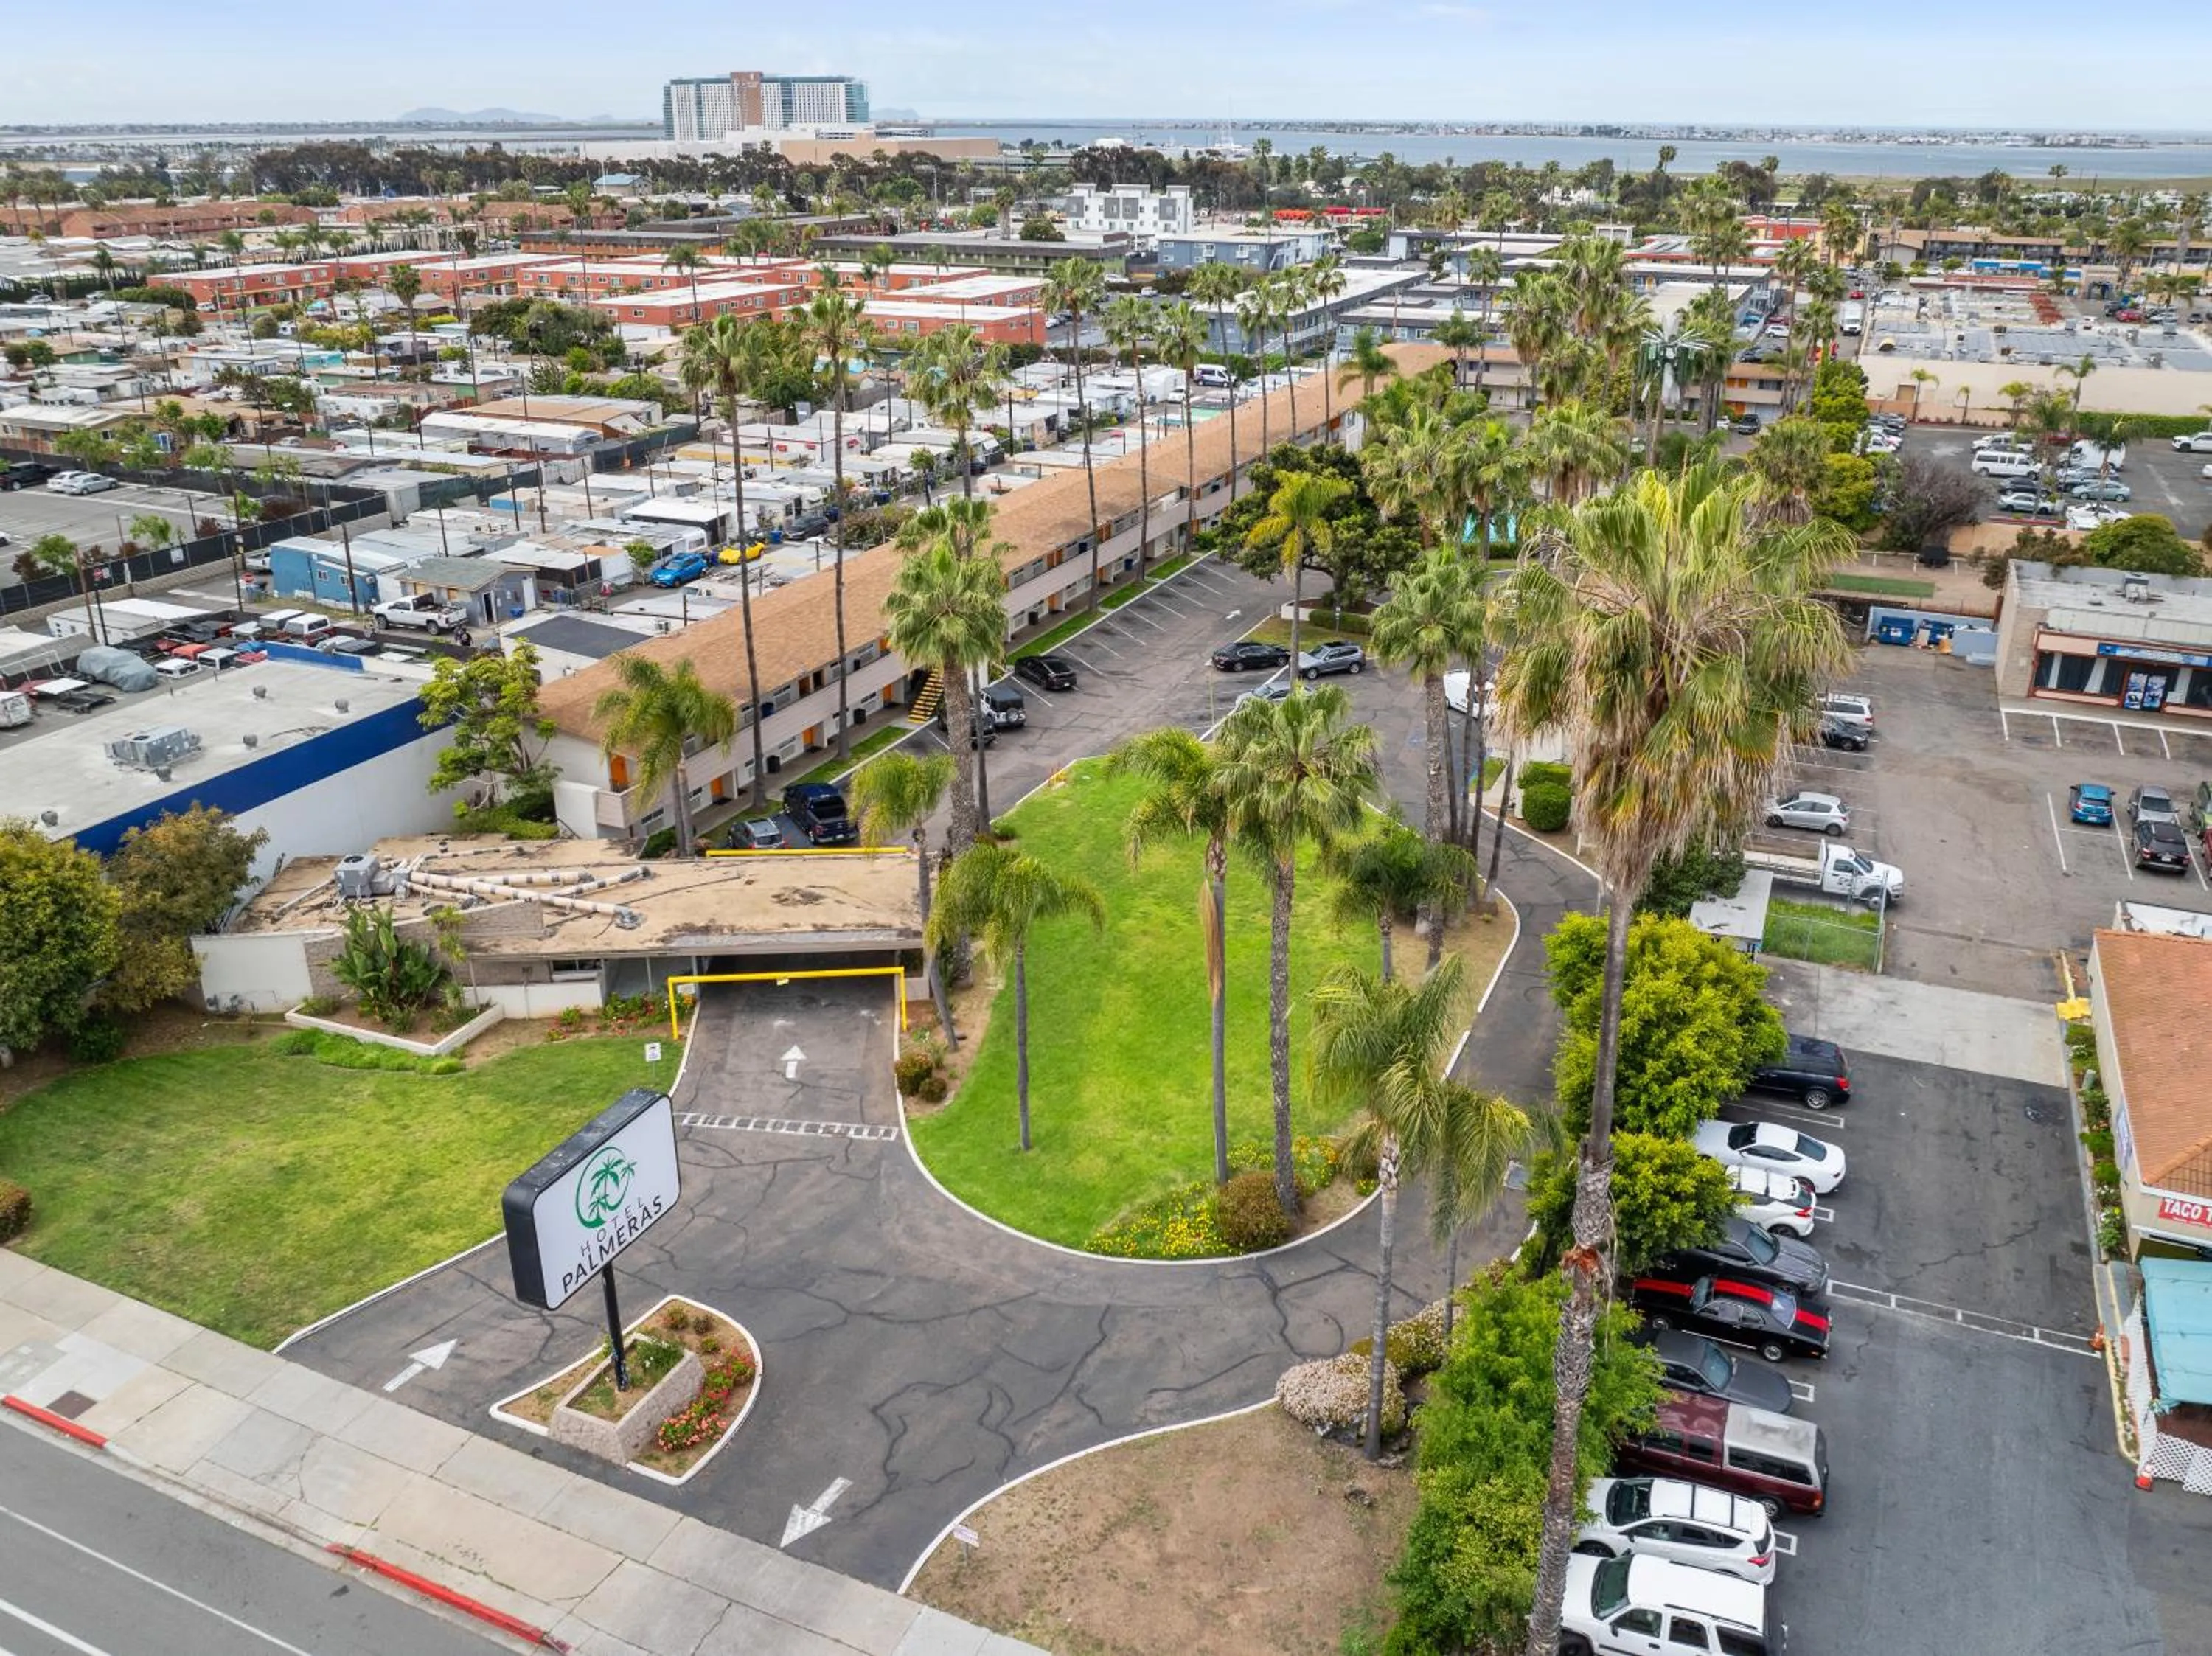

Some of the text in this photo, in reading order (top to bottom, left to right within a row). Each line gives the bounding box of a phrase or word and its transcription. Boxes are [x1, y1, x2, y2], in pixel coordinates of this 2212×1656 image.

[580, 1196, 644, 1257] HOTEL
[2164, 1198, 2202, 1220] TACO
[562, 1194, 662, 1294] PALMERAS
